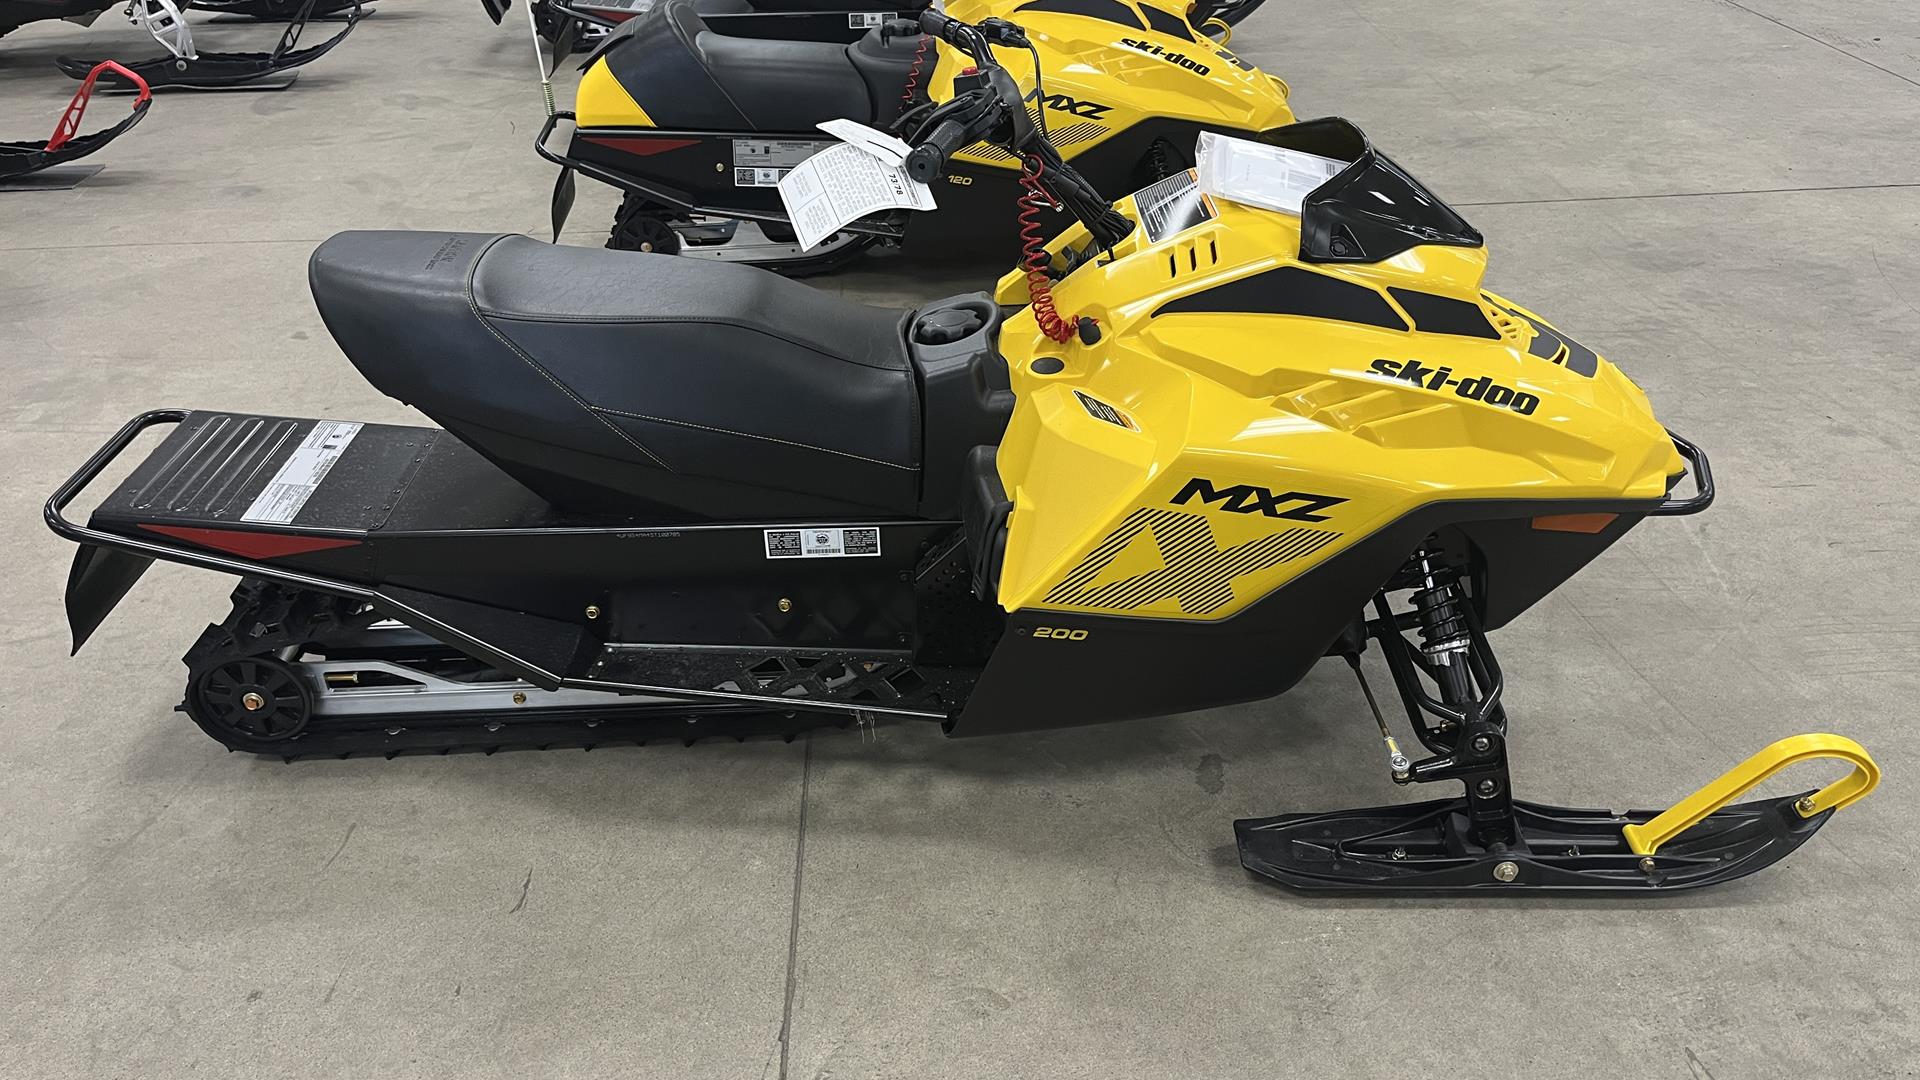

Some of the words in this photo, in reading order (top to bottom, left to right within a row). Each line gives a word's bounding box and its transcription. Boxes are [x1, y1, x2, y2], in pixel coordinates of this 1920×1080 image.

[1120, 37, 1211, 77] ski-doo
[1023, 88, 1115, 121] MXZ
[947, 174, 973, 186] 120
[1370, 358, 1540, 416] ski-doo
[1171, 477, 1350, 522] MXZ
[1033, 626, 1089, 641] 200
